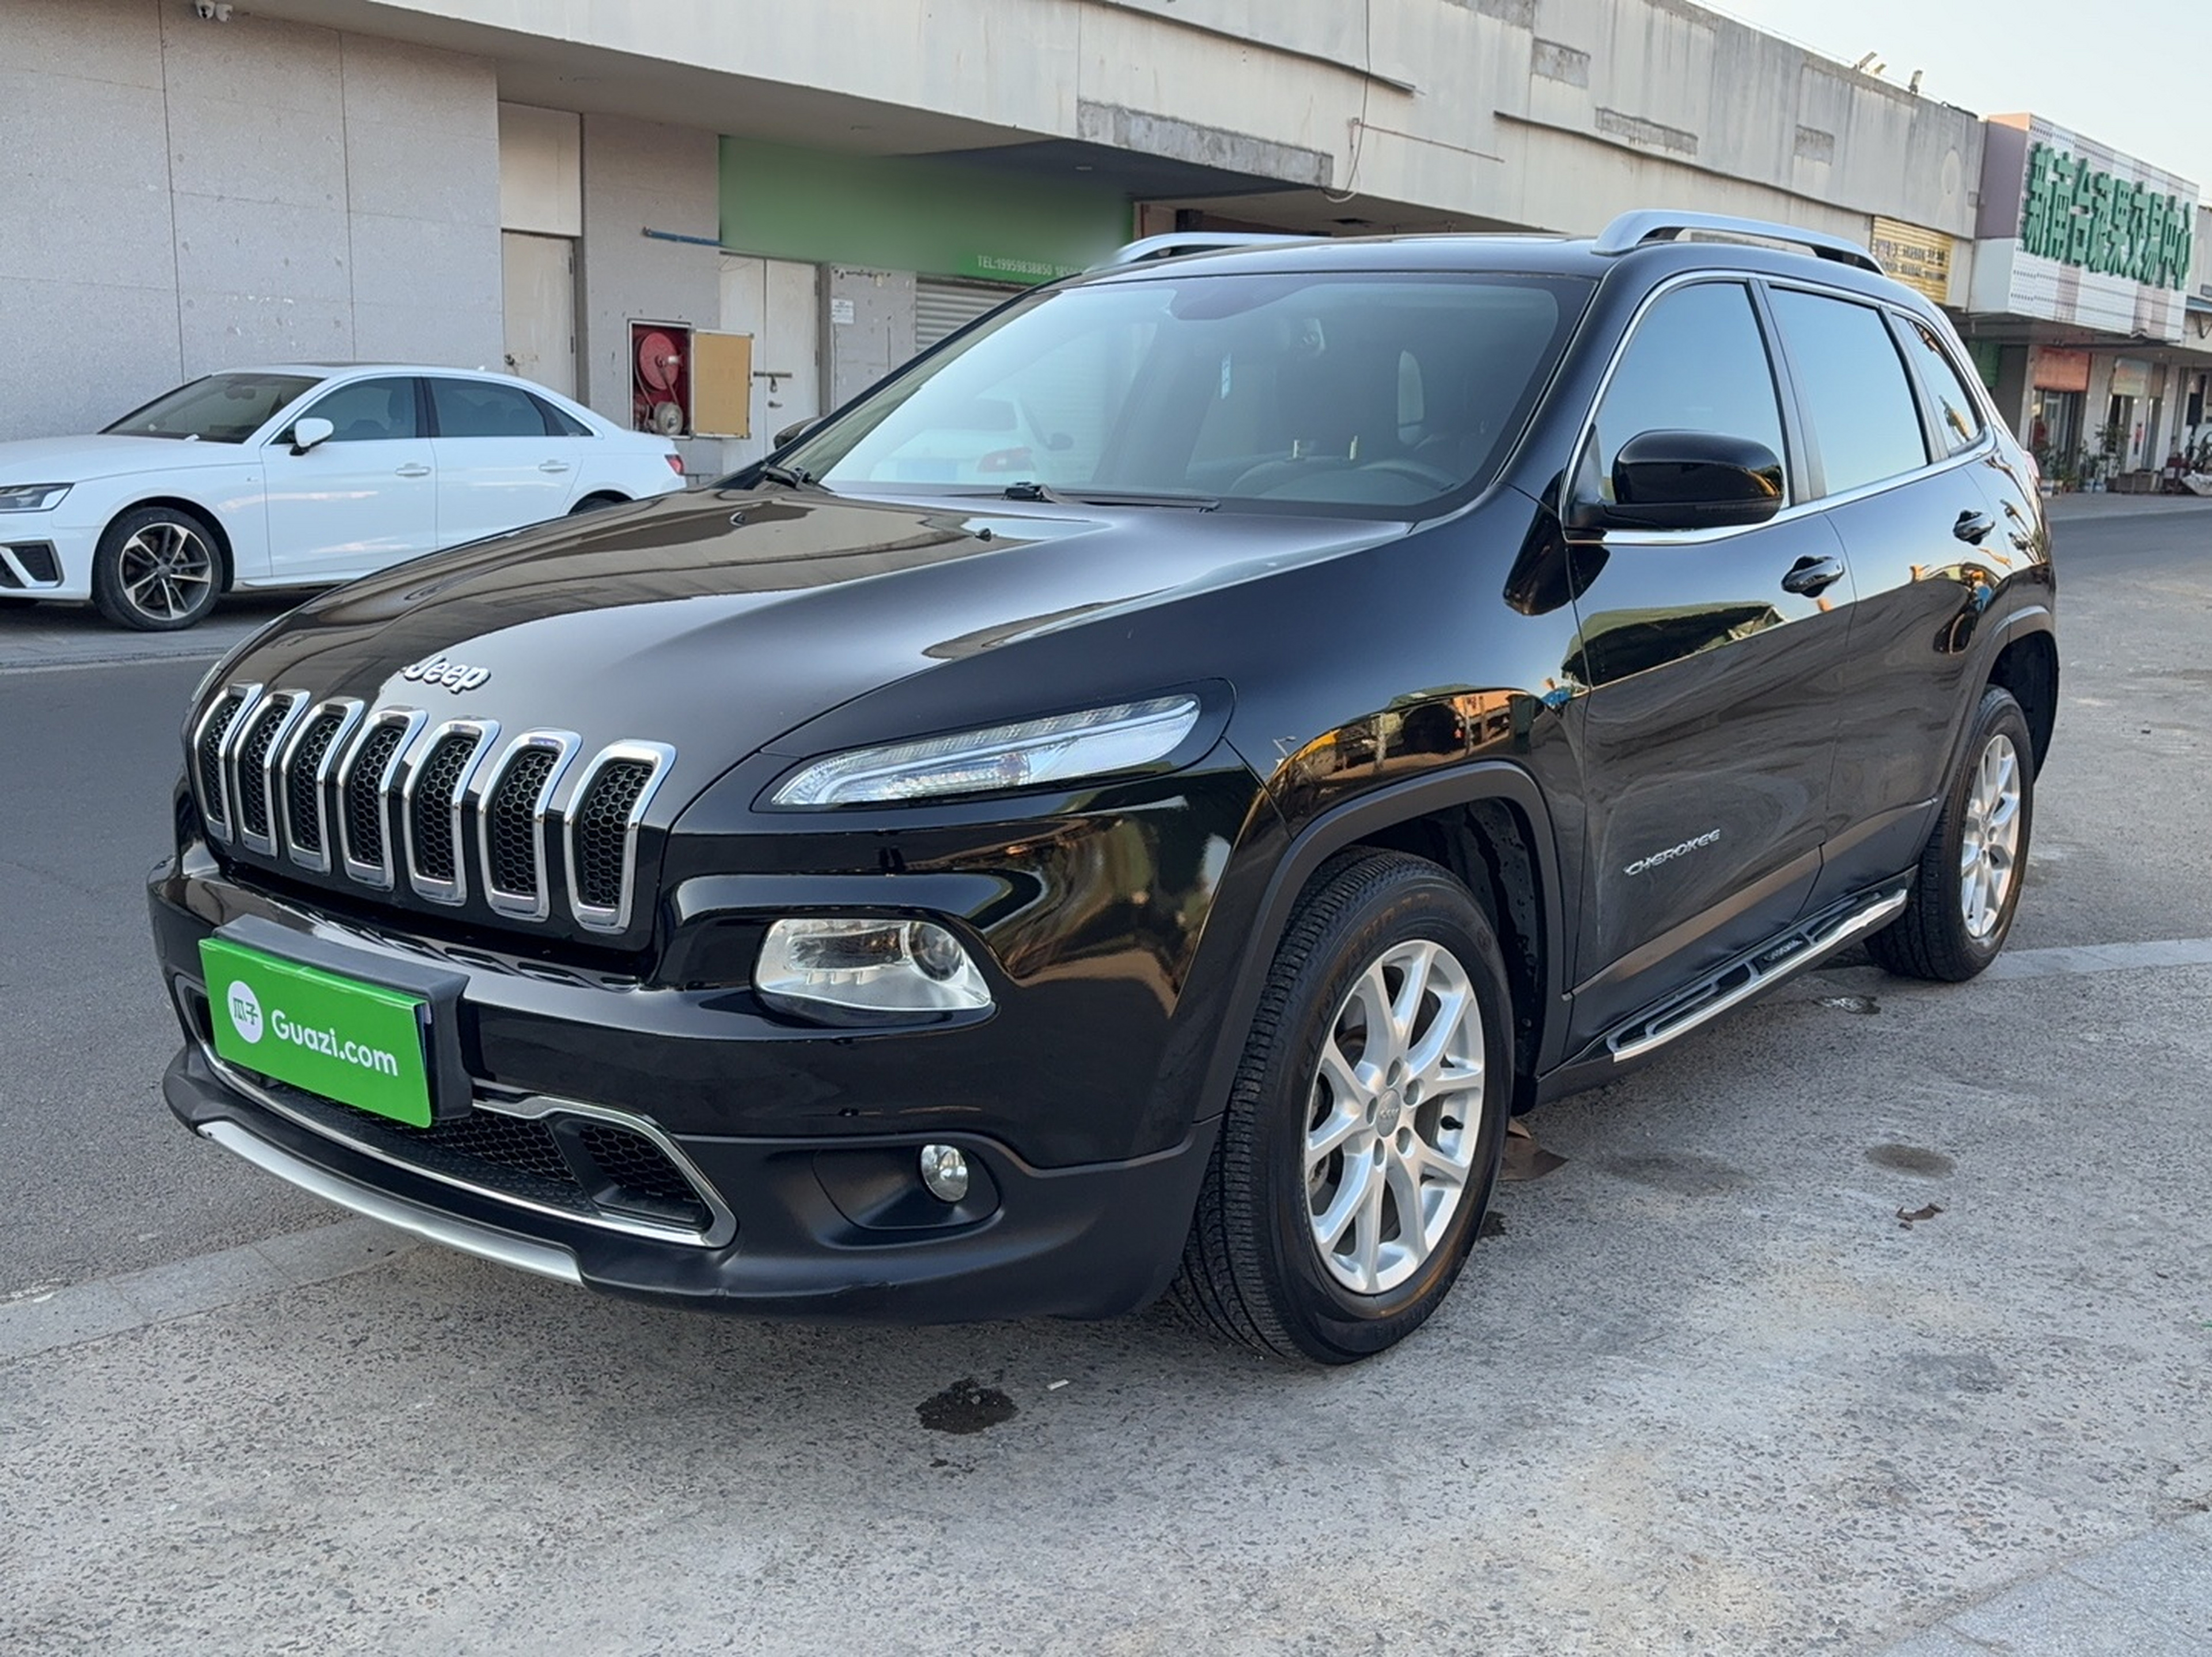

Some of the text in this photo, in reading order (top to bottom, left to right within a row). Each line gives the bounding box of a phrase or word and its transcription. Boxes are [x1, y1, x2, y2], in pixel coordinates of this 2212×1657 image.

[403, 655, 491, 695] Jeep
[1623, 828, 1721, 876] CHEROKEE
[232, 997, 259, 1026] 瓜子
[271, 1009, 399, 1077] Guazi.com
